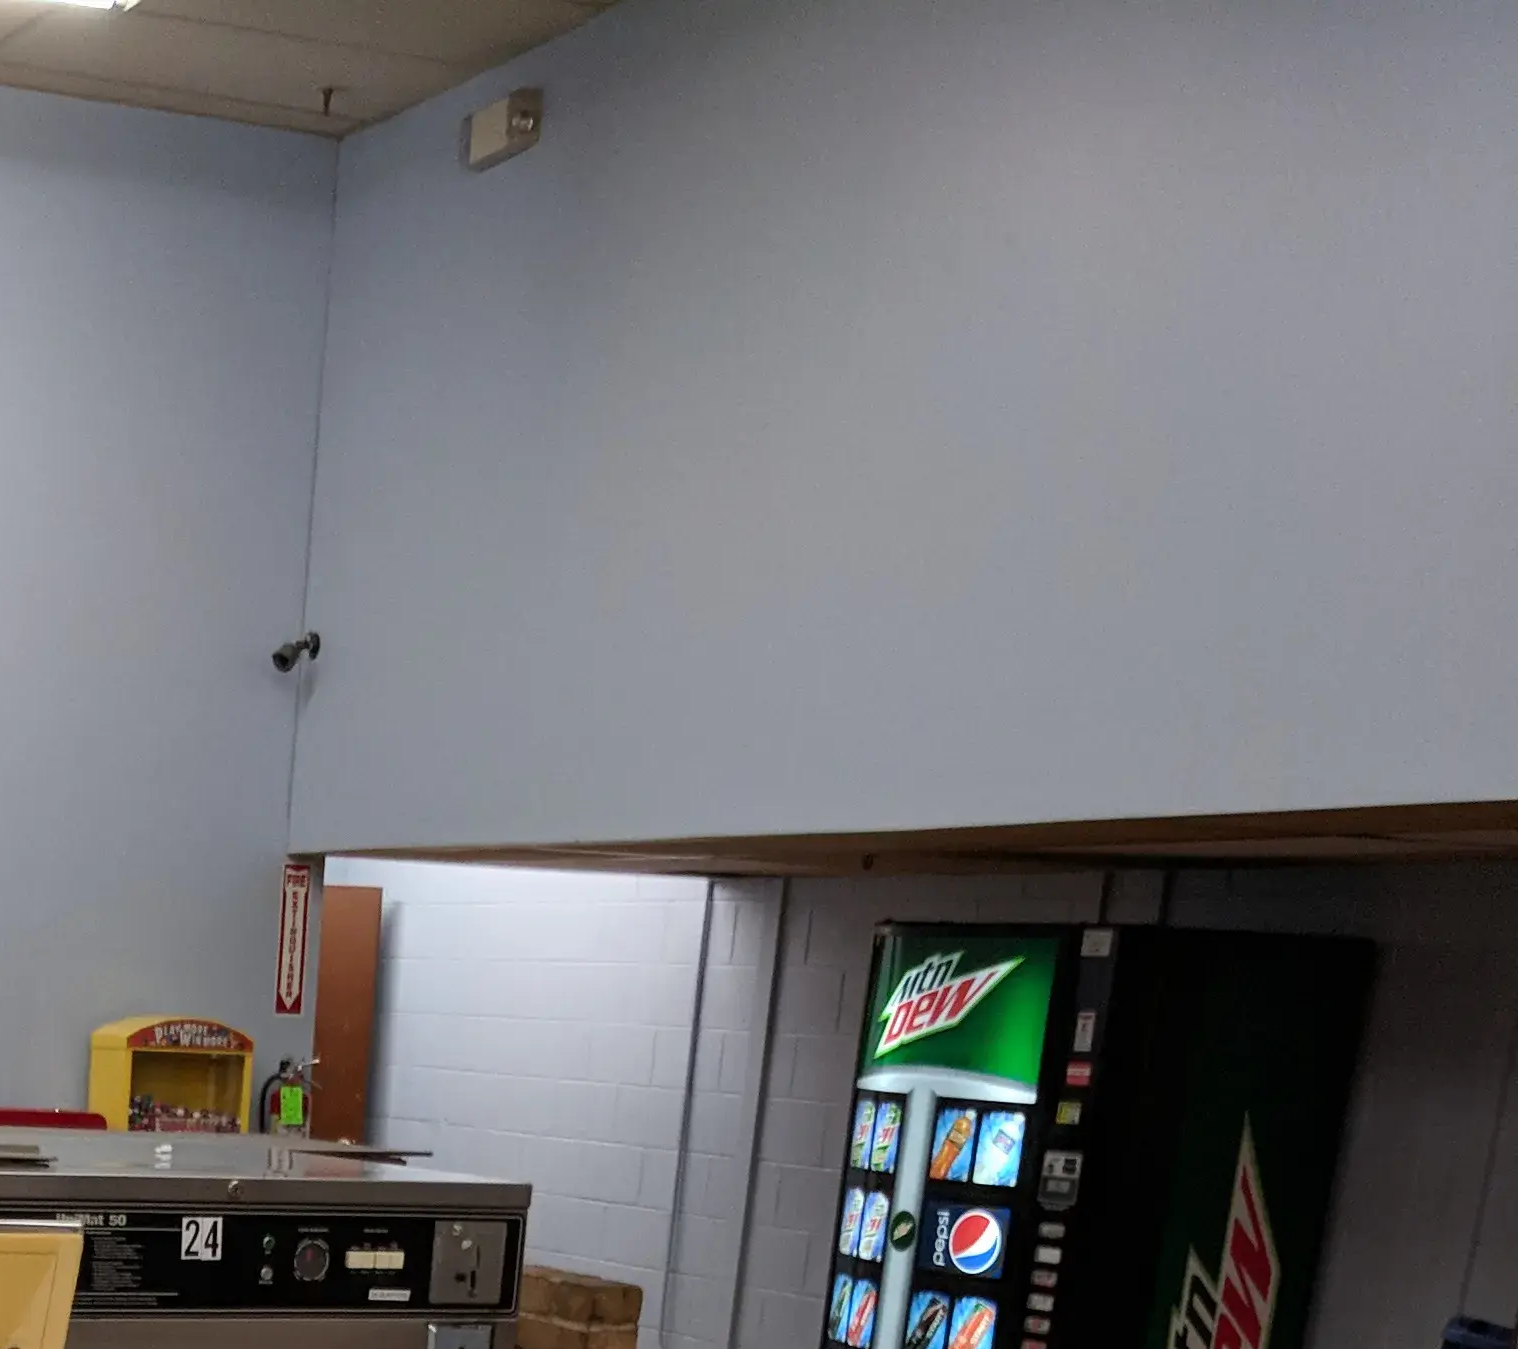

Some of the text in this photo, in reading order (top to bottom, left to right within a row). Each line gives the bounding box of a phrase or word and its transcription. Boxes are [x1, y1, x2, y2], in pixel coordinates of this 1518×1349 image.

[108, 1214, 127, 1227] 50
[184, 1219, 220, 1259] 24
[932, 1210, 951, 1268] pepsi
